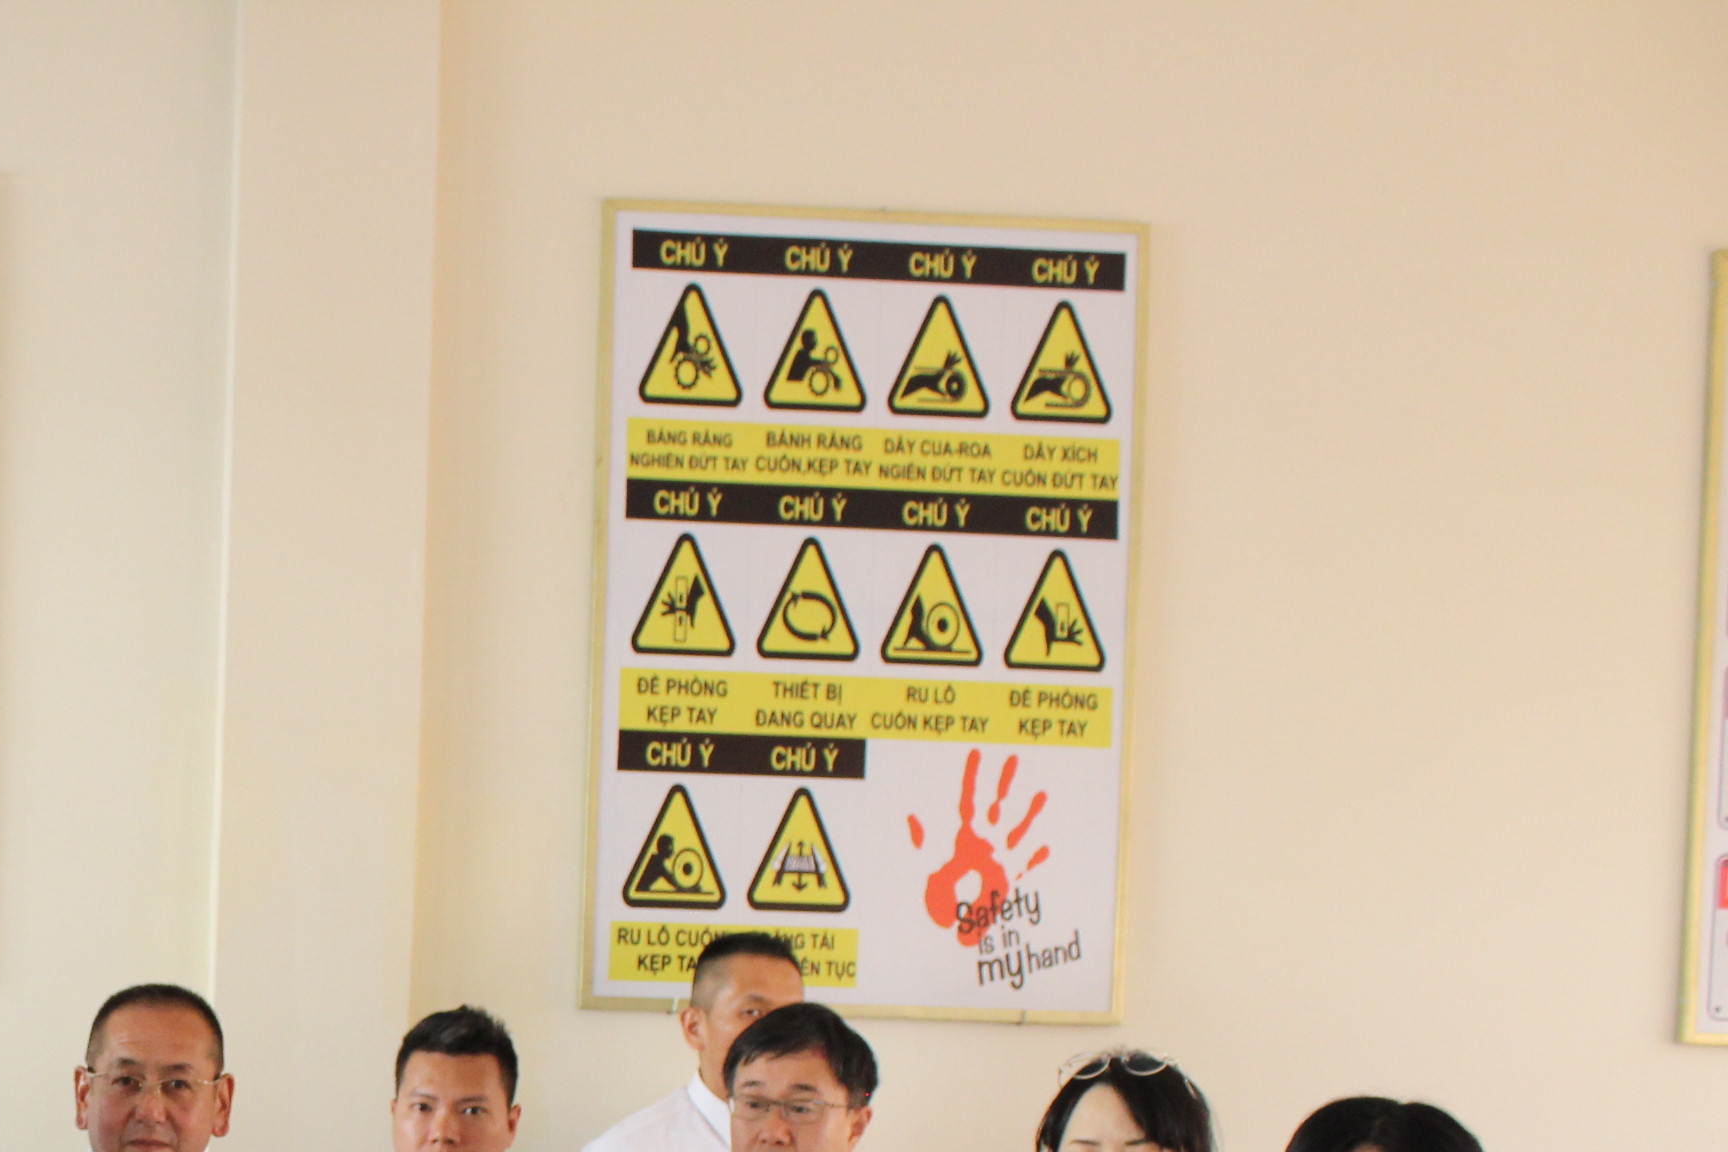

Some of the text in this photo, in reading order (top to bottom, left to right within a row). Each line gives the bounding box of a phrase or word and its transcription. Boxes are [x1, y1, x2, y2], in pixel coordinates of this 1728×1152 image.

[659, 235, 729, 268] CHÚ Ý
[784, 240, 853, 273] CHÚ Ý
[908, 247, 977, 279] CHÚ Ý
[1032, 253, 1100, 285] CHÚ Ý
[725, 457, 749, 473] TAY
[969, 467, 997, 484] TAY
[1092, 474, 1117, 490] TAY
[653, 484, 722, 517] CHÚ Ý
[779, 489, 847, 521] CHÚ Ý
[902, 495, 970, 527] CHÚ Ý
[1025, 501, 1094, 533] CHÚ Ý
[684, 707, 718, 724] TAY
[810, 710, 857, 731] QUAY
[958, 716, 989, 733] TAY
[1056, 719, 1088, 737] TAY
[646, 736, 714, 768] CHÚ Ý
[770, 739, 839, 771] CHÚ Ý
[955, 886, 1042, 939] Safety
[979, 926, 1020, 955] is in
[675, 957, 695, 974] TA
[978, 931, 1081, 989] my hand
